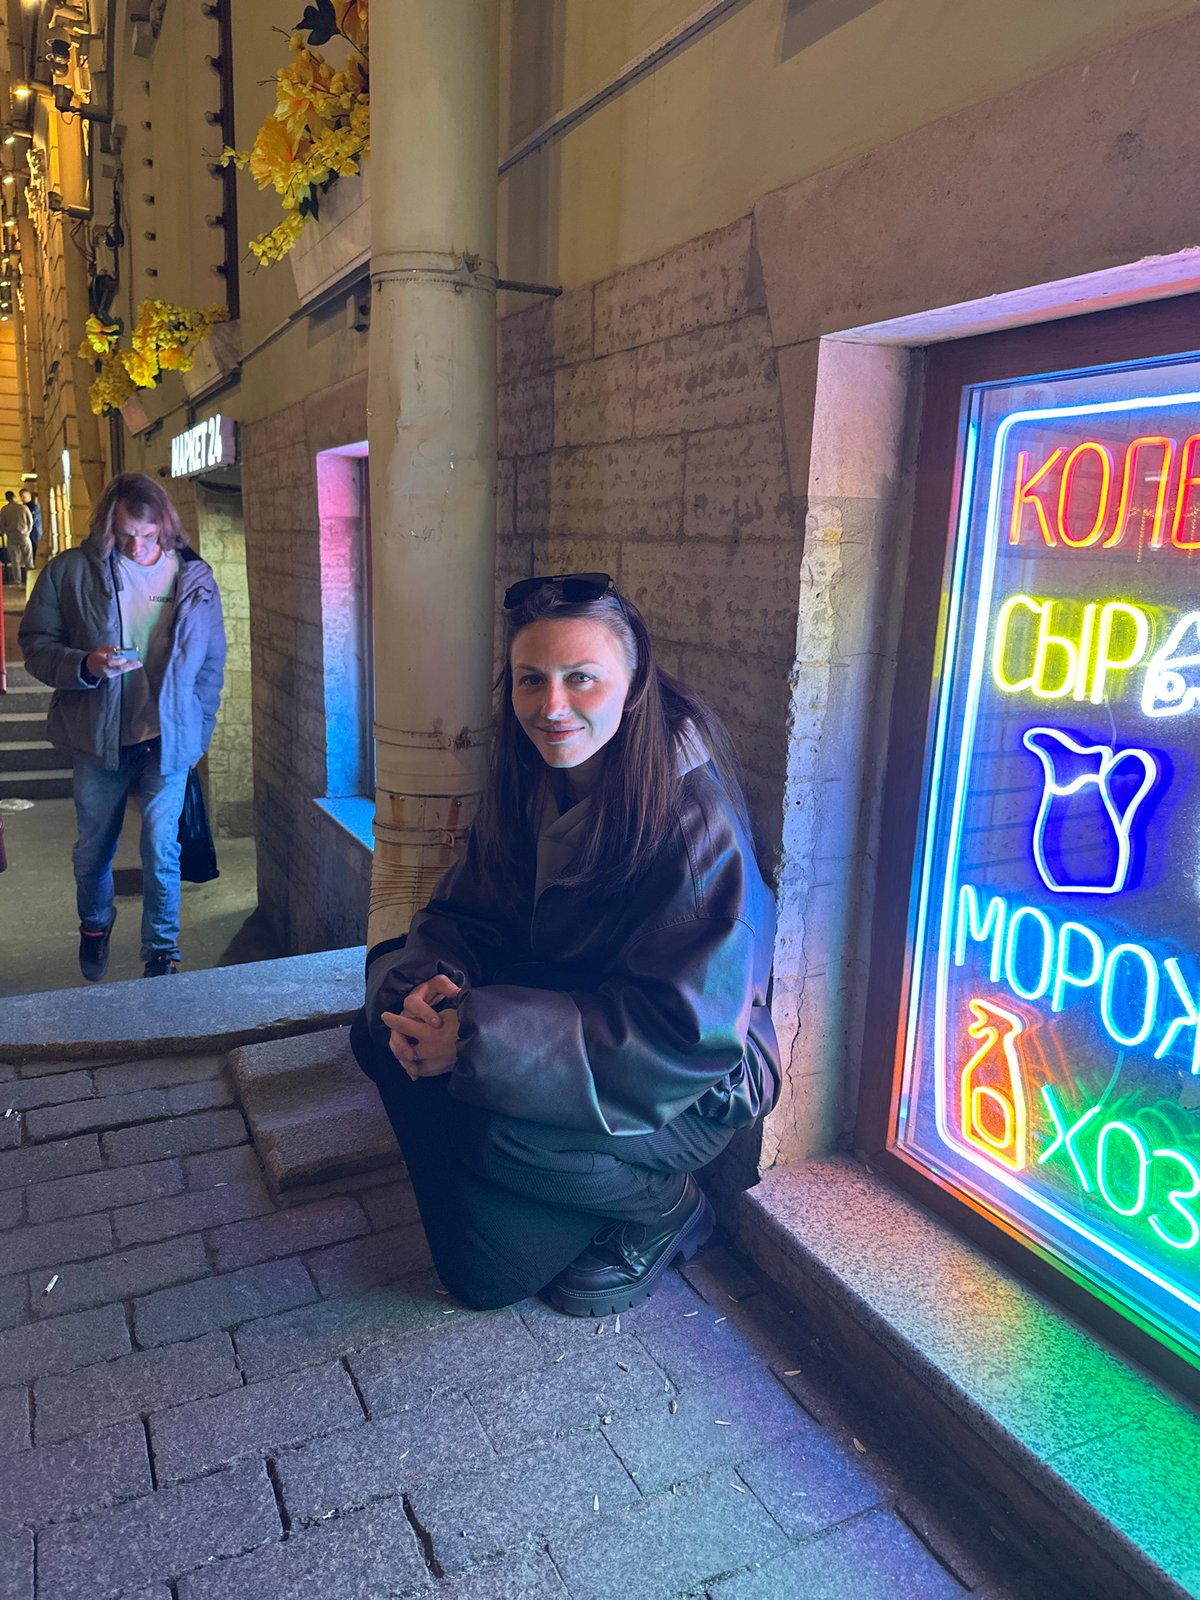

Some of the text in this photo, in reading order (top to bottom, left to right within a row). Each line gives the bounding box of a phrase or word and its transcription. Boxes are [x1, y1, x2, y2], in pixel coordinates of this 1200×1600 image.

[171, 413, 222, 478] МАРКЕТ 24
[993, 595, 1150, 704] СЫР
[1037, 1084, 1200, 1249] ХОЗ
